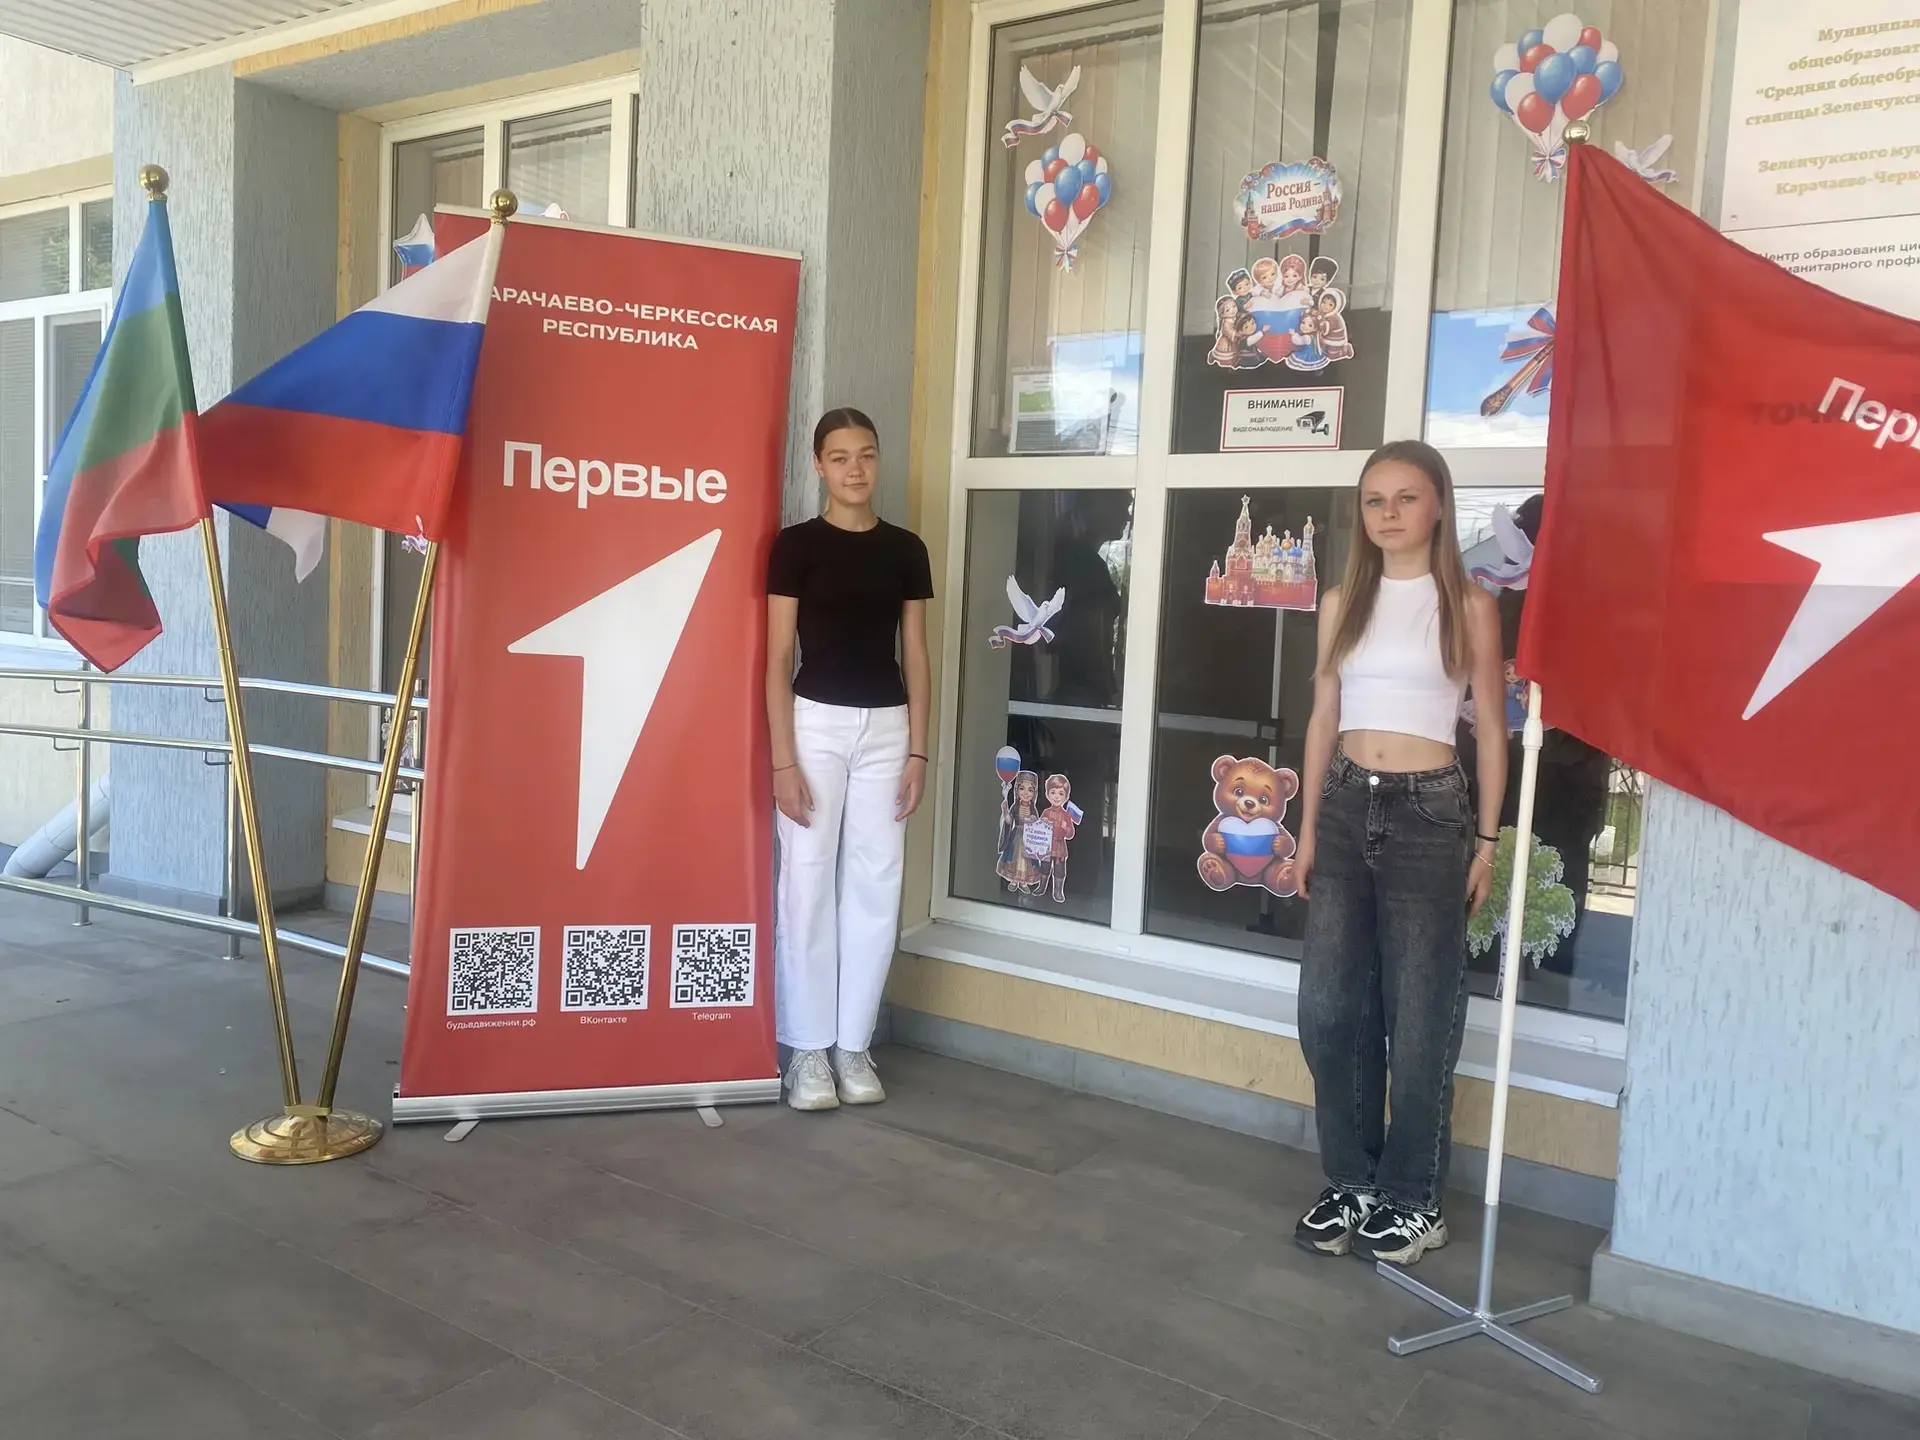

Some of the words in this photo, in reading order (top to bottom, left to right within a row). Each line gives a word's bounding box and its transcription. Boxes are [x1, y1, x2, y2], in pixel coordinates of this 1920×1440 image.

[1745, 106, 1820, 126] станицы
[1758, 148, 1888, 173] Зеленчукского
[1266, 180, 1312, 199] Россия
[1261, 202, 1287, 214] наша
[1804, 243, 1895, 260] образования
[489, 285, 778, 334] АРАЧАЕВО-ЧЕРКЕССКАЯ
[542, 318, 699, 350] РЕСПУБЛИКА
[1248, 398, 1315, 409] ВНИМАНИЕ!
[1817, 376, 1920, 452] Пер
[503, 440, 728, 509] Первые
[446, 1018, 537, 1030] будьвдвижении.рф
[580, 1016, 628, 1025] ВКонтакте
[692, 1012, 731, 1022] Telegram
